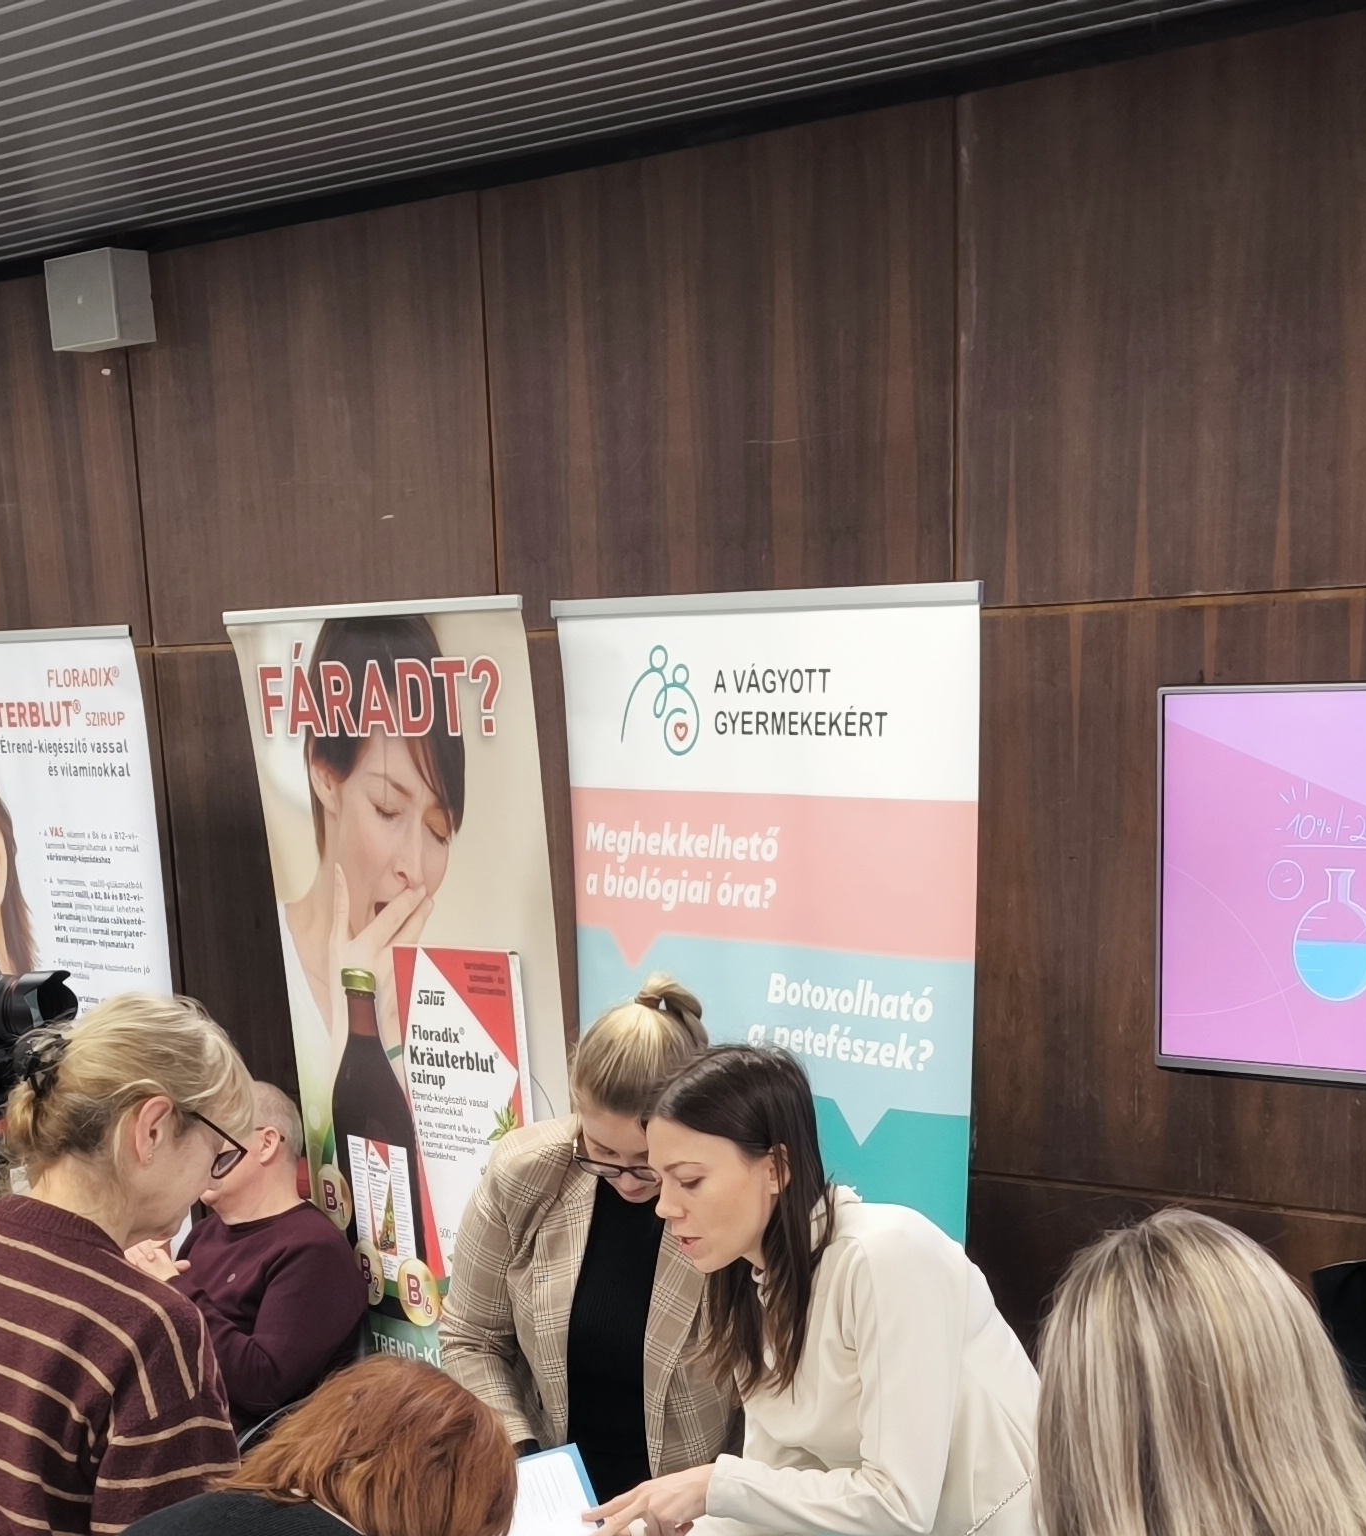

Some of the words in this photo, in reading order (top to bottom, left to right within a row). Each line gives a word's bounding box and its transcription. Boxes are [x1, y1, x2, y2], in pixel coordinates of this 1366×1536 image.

[257, 641, 501, 737] FÁRADT?
[714, 669, 726, 694] A
[733, 663, 831, 694] VÁGYOTT
[85, 711, 125, 726] SZIRUP
[714, 706, 888, 737] GYERMEKEKÉRT
[0, 735, 87, 757] Étrend-kiegészítő
[90, 739, 129, 754] vassal
[48, 761, 59, 777] és
[61, 761, 131, 777] vitaminokkal
[585, 820, 781, 863] Meghekkelhető
[586, 873, 598, 895] a
[603, 863, 712, 912] biológiai
[717, 872, 777, 909] óra?
[417, 989, 445, 1006] Salus
[767, 972, 934, 1023] Botoxolható
[774, 1023, 934, 1072] petefészek?
[411, 1069, 446, 1090] szirup
